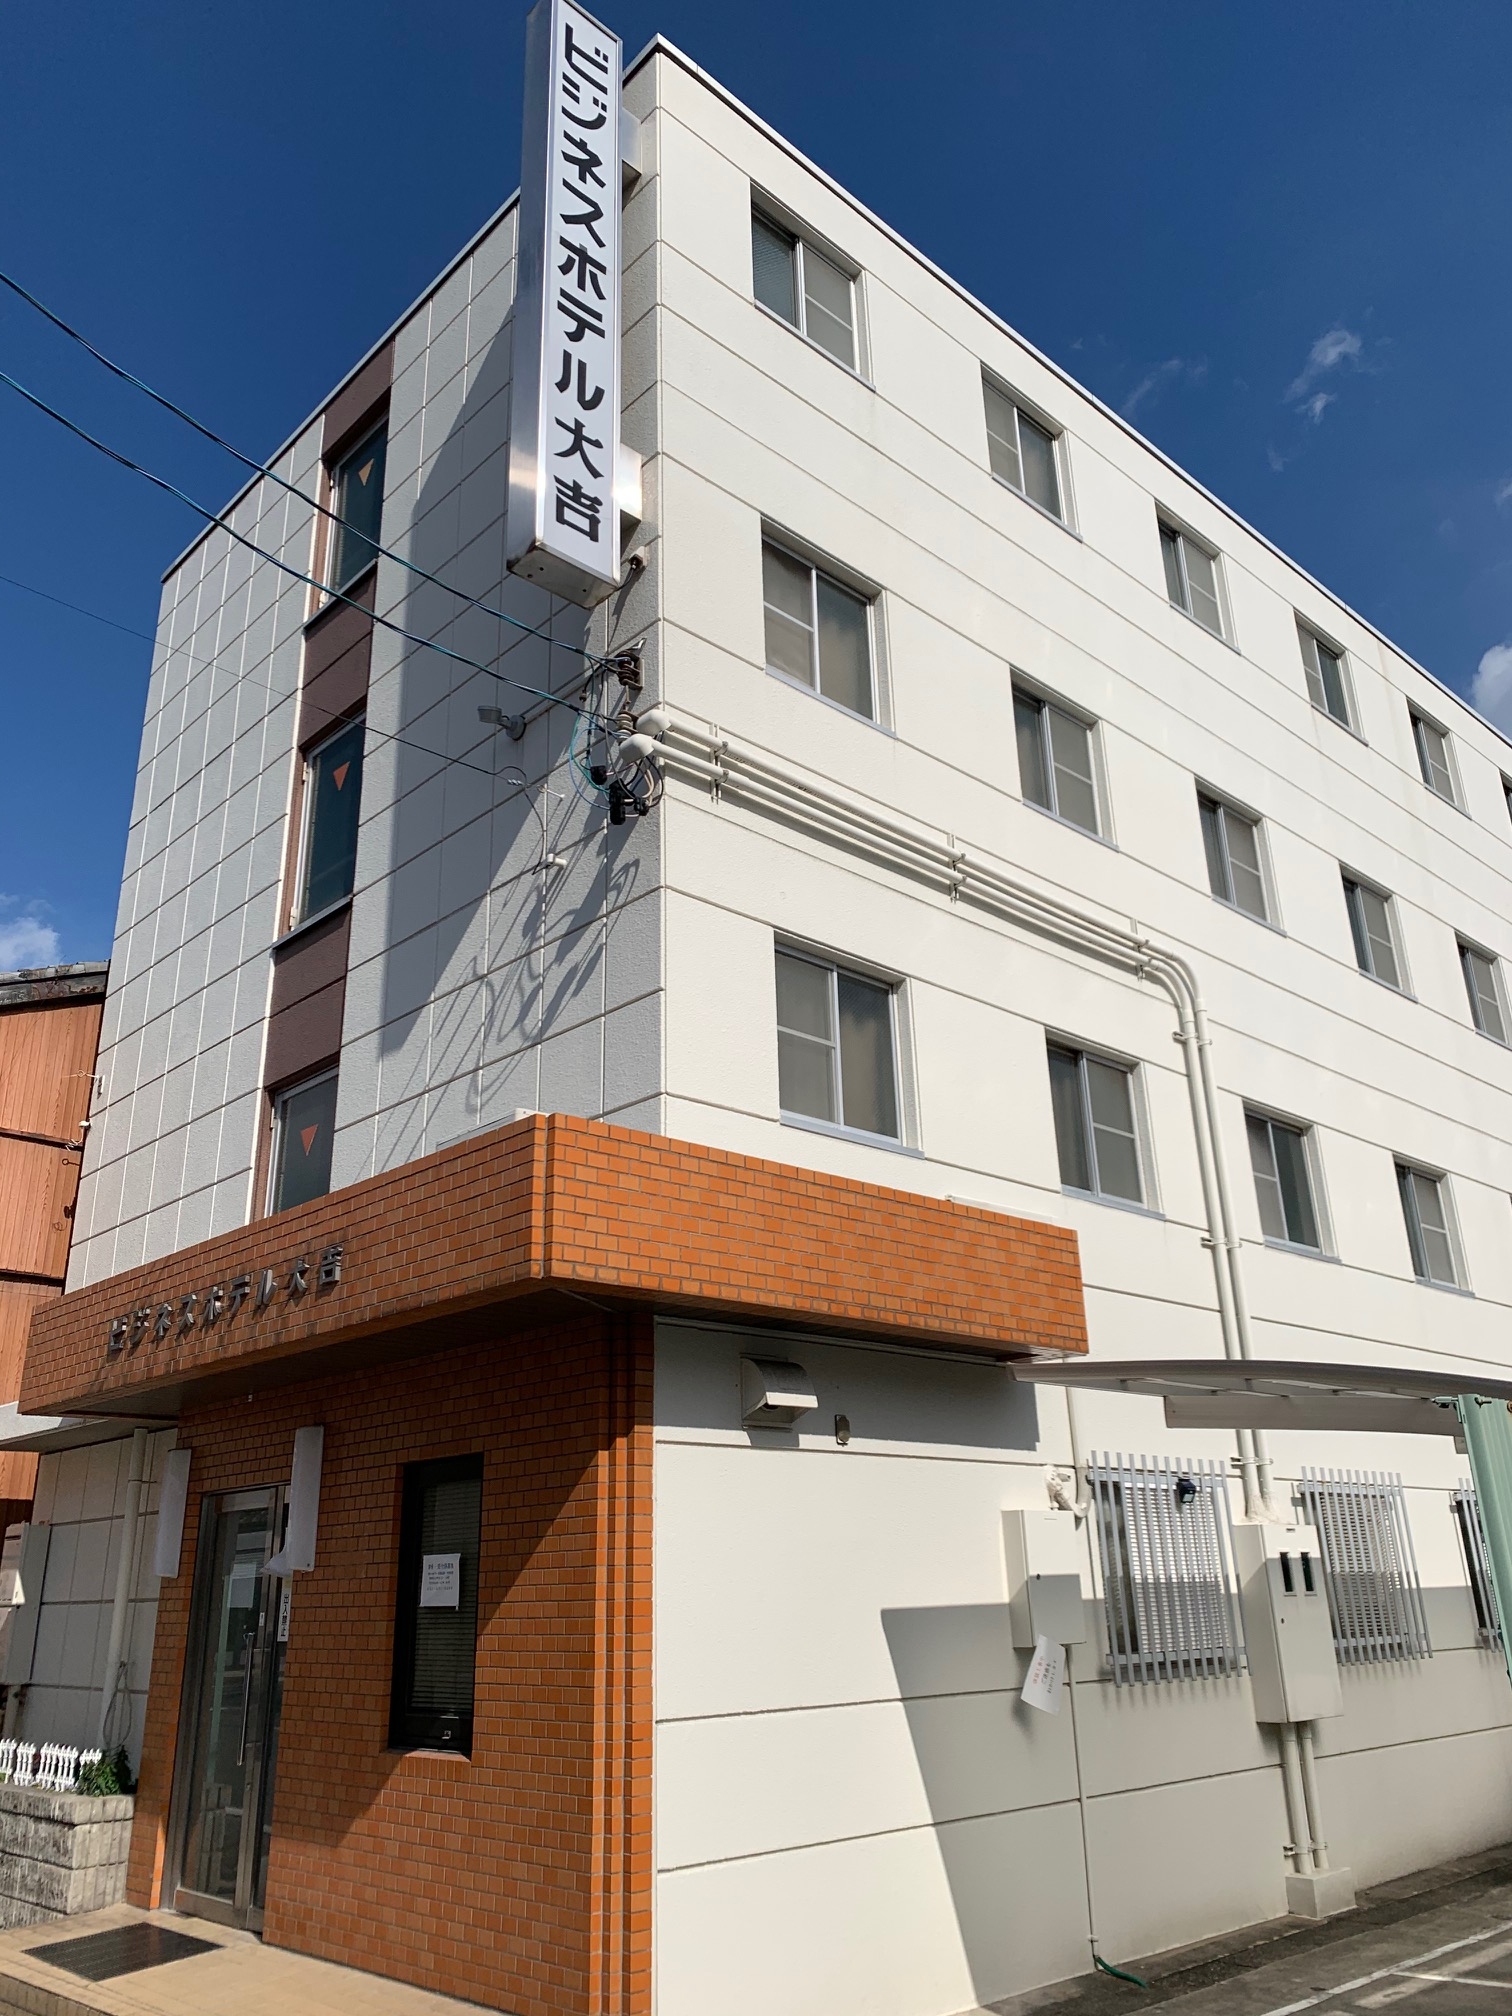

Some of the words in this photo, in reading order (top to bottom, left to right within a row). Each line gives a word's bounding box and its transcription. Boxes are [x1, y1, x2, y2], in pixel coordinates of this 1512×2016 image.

[554, 22, 609, 543] ビジネスホテル大吉
